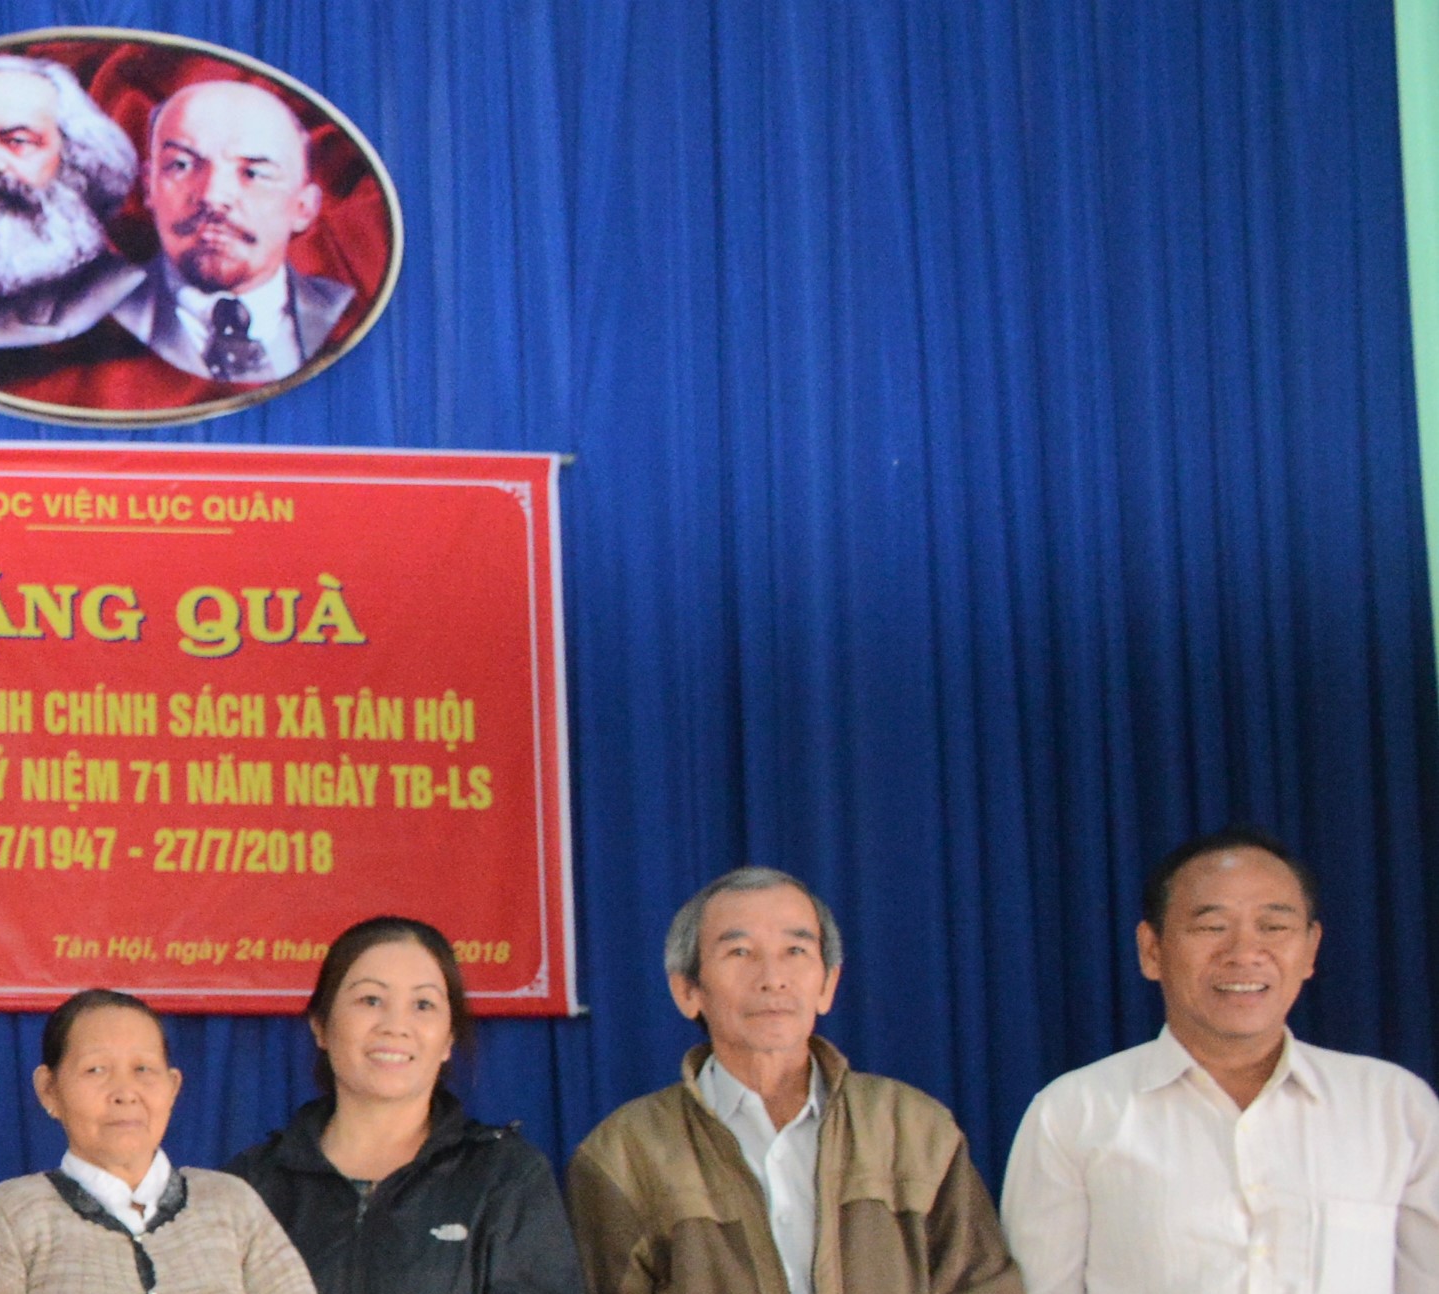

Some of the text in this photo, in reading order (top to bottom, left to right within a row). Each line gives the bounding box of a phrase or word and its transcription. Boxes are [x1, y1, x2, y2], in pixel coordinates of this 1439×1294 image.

[41, 486, 118, 523] VIỆN
[128, 495, 193, 525] LỤC
[202, 490, 295, 523] QUÂN
[175, 571, 369, 660] QUÀ
[44, 683, 159, 737] CHÍNH
[167, 684, 266, 739] SÁCH
[275, 685, 327, 740] XÃ
[333, 686, 404, 741] TÂN
[414, 688, 476, 752] HỘI
[21, 749, 121, 813] NIỆM
[129, 760, 171, 804] 71
[185, 752, 274, 806] NĂM
[283, 753, 379, 808] NGÀY
[389, 764, 493, 811] TB-LS
[128, 845, 143, 858] -
[153, 828, 335, 875] 27/7/2018
[52, 934, 100, 960] Tân
[165, 940, 226, 967] ngày
[233, 939, 265, 960] 24
[271, 939, 329, 961] thán
[454, 940, 512, 965] 2018
